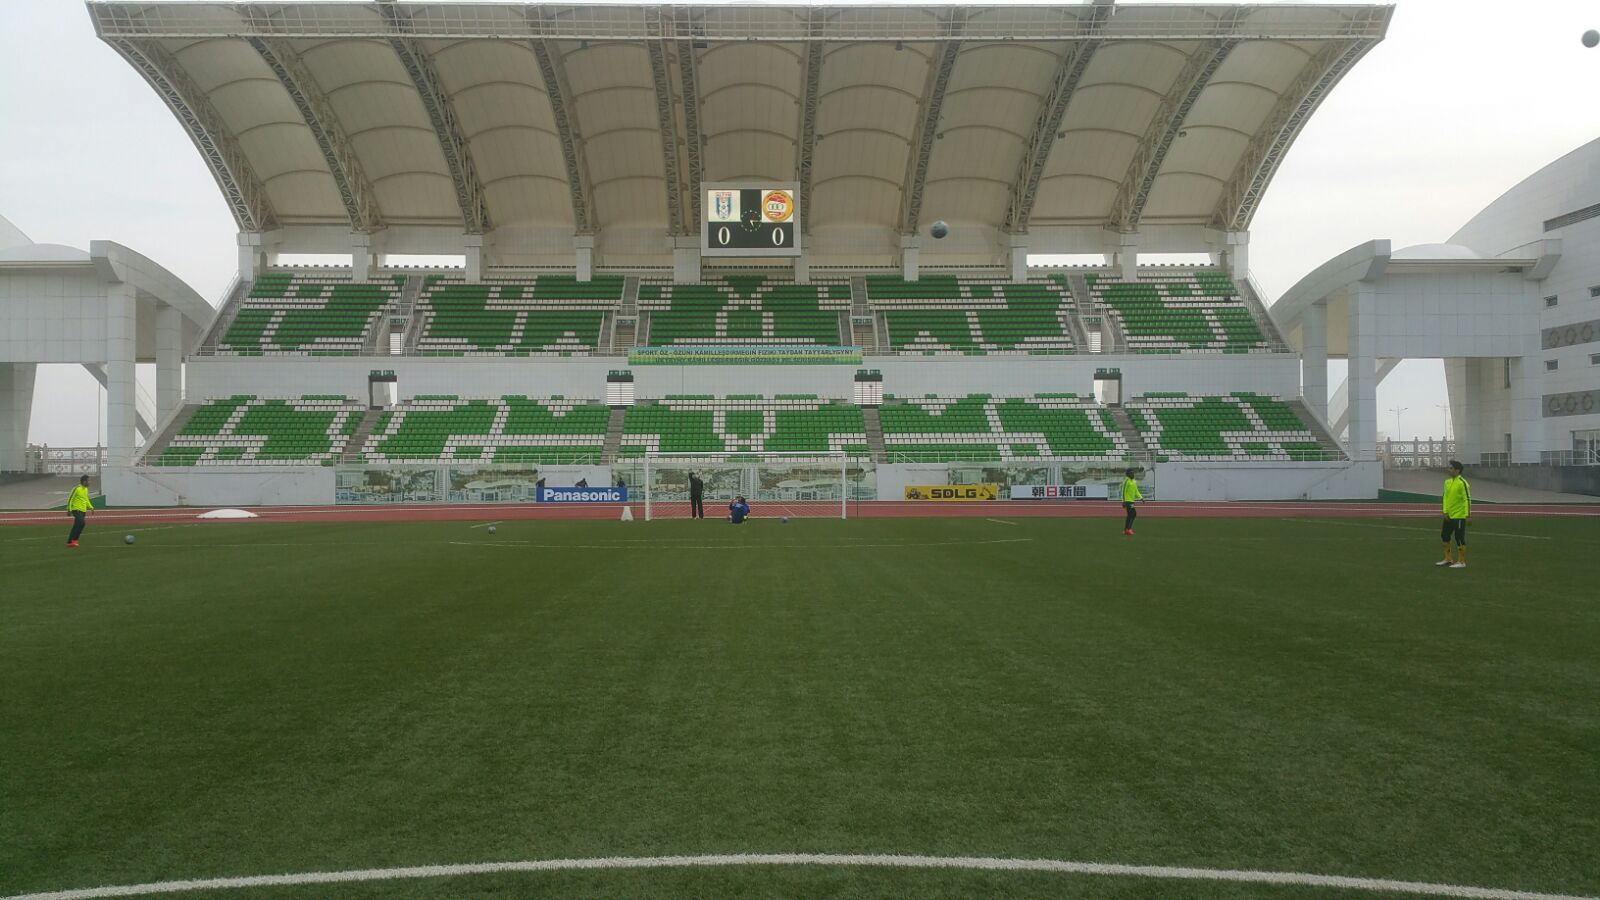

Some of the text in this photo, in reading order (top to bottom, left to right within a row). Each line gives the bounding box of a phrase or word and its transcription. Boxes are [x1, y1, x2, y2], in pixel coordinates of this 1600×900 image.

[718, 226, 784, 246] 0 0
[543, 488, 621, 502] Panasonic
[931, 488, 977, 499] SDLG
[1031, 485, 1087, 497] 朝日新聞
